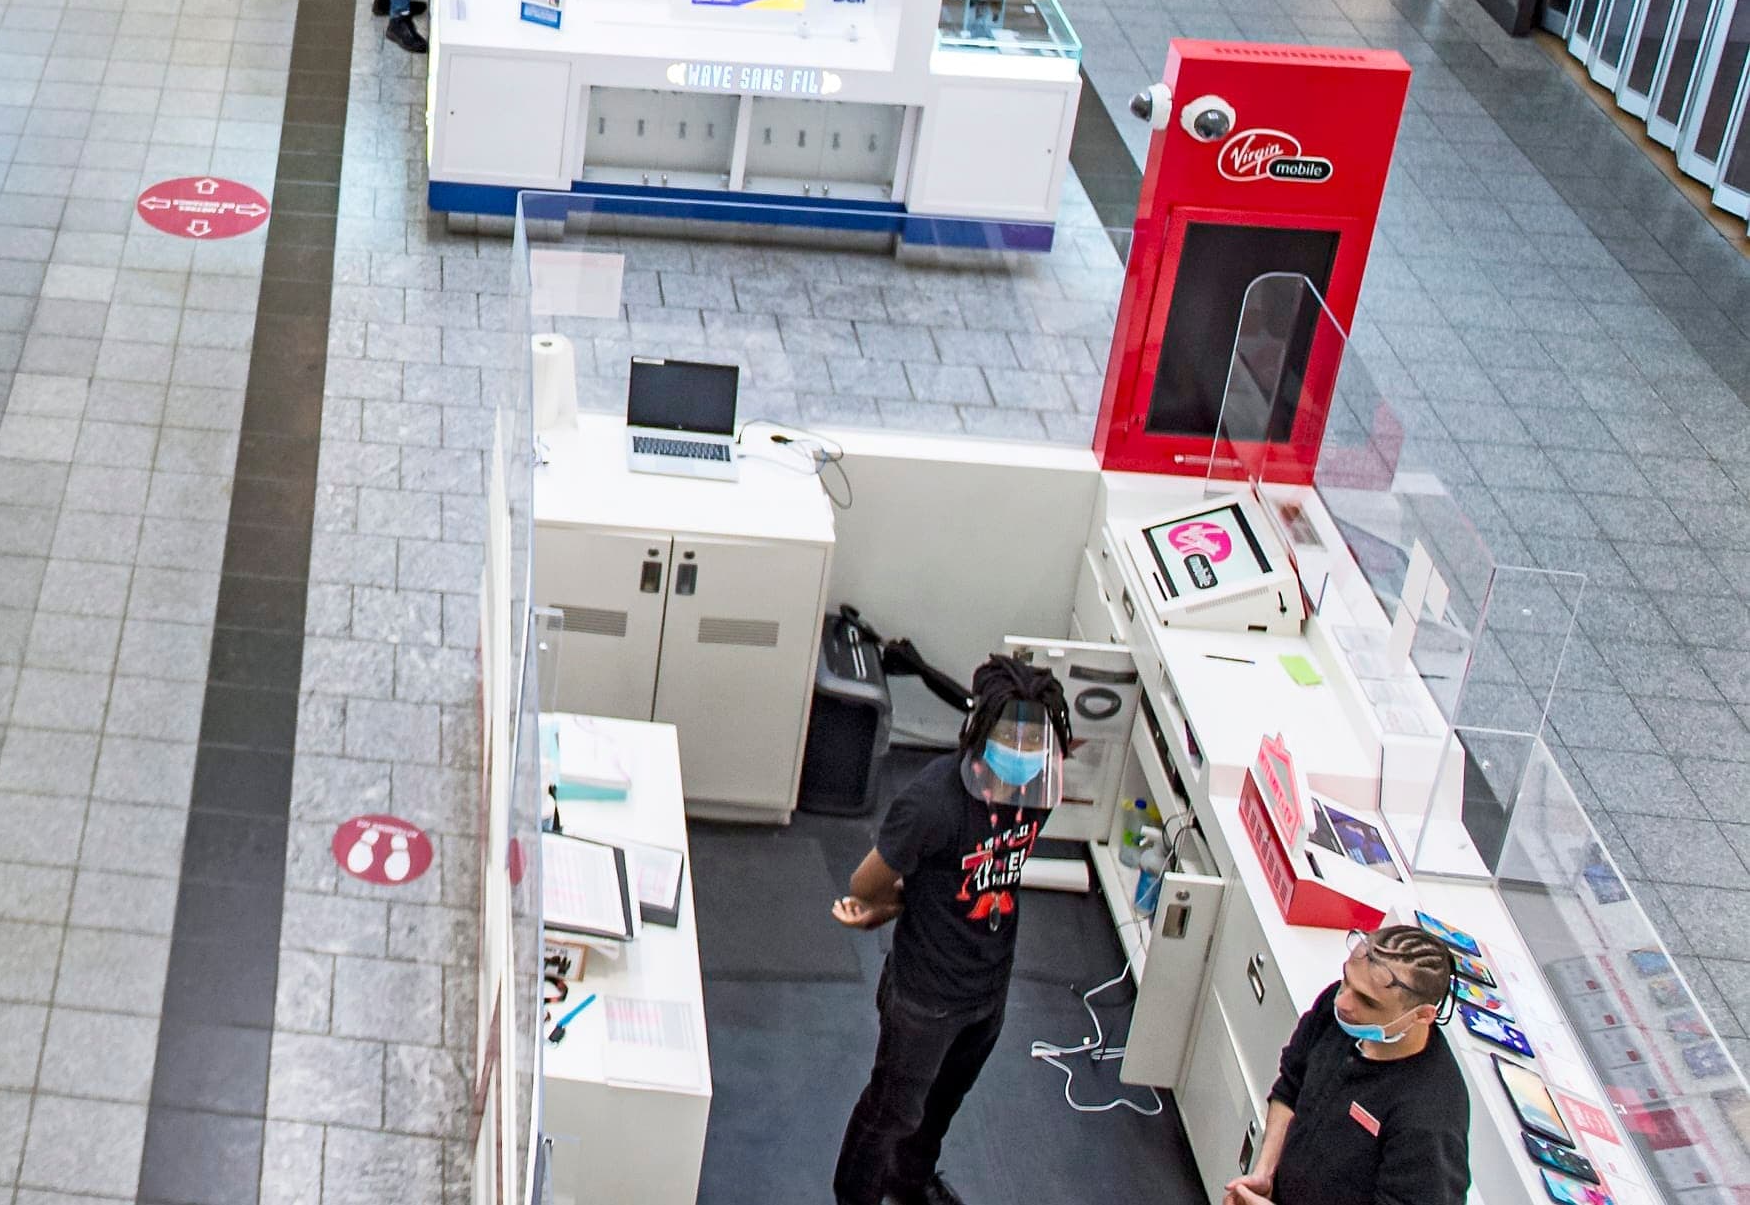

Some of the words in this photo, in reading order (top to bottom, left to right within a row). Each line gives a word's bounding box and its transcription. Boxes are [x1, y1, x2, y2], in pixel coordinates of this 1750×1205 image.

[686, 62, 733, 89] WAVE
[739, 68, 784, 92] SANS
[791, 70, 820, 94] FIL
[1230, 134, 1284, 176] Virgin
[1275, 162, 1323, 178] mobile
